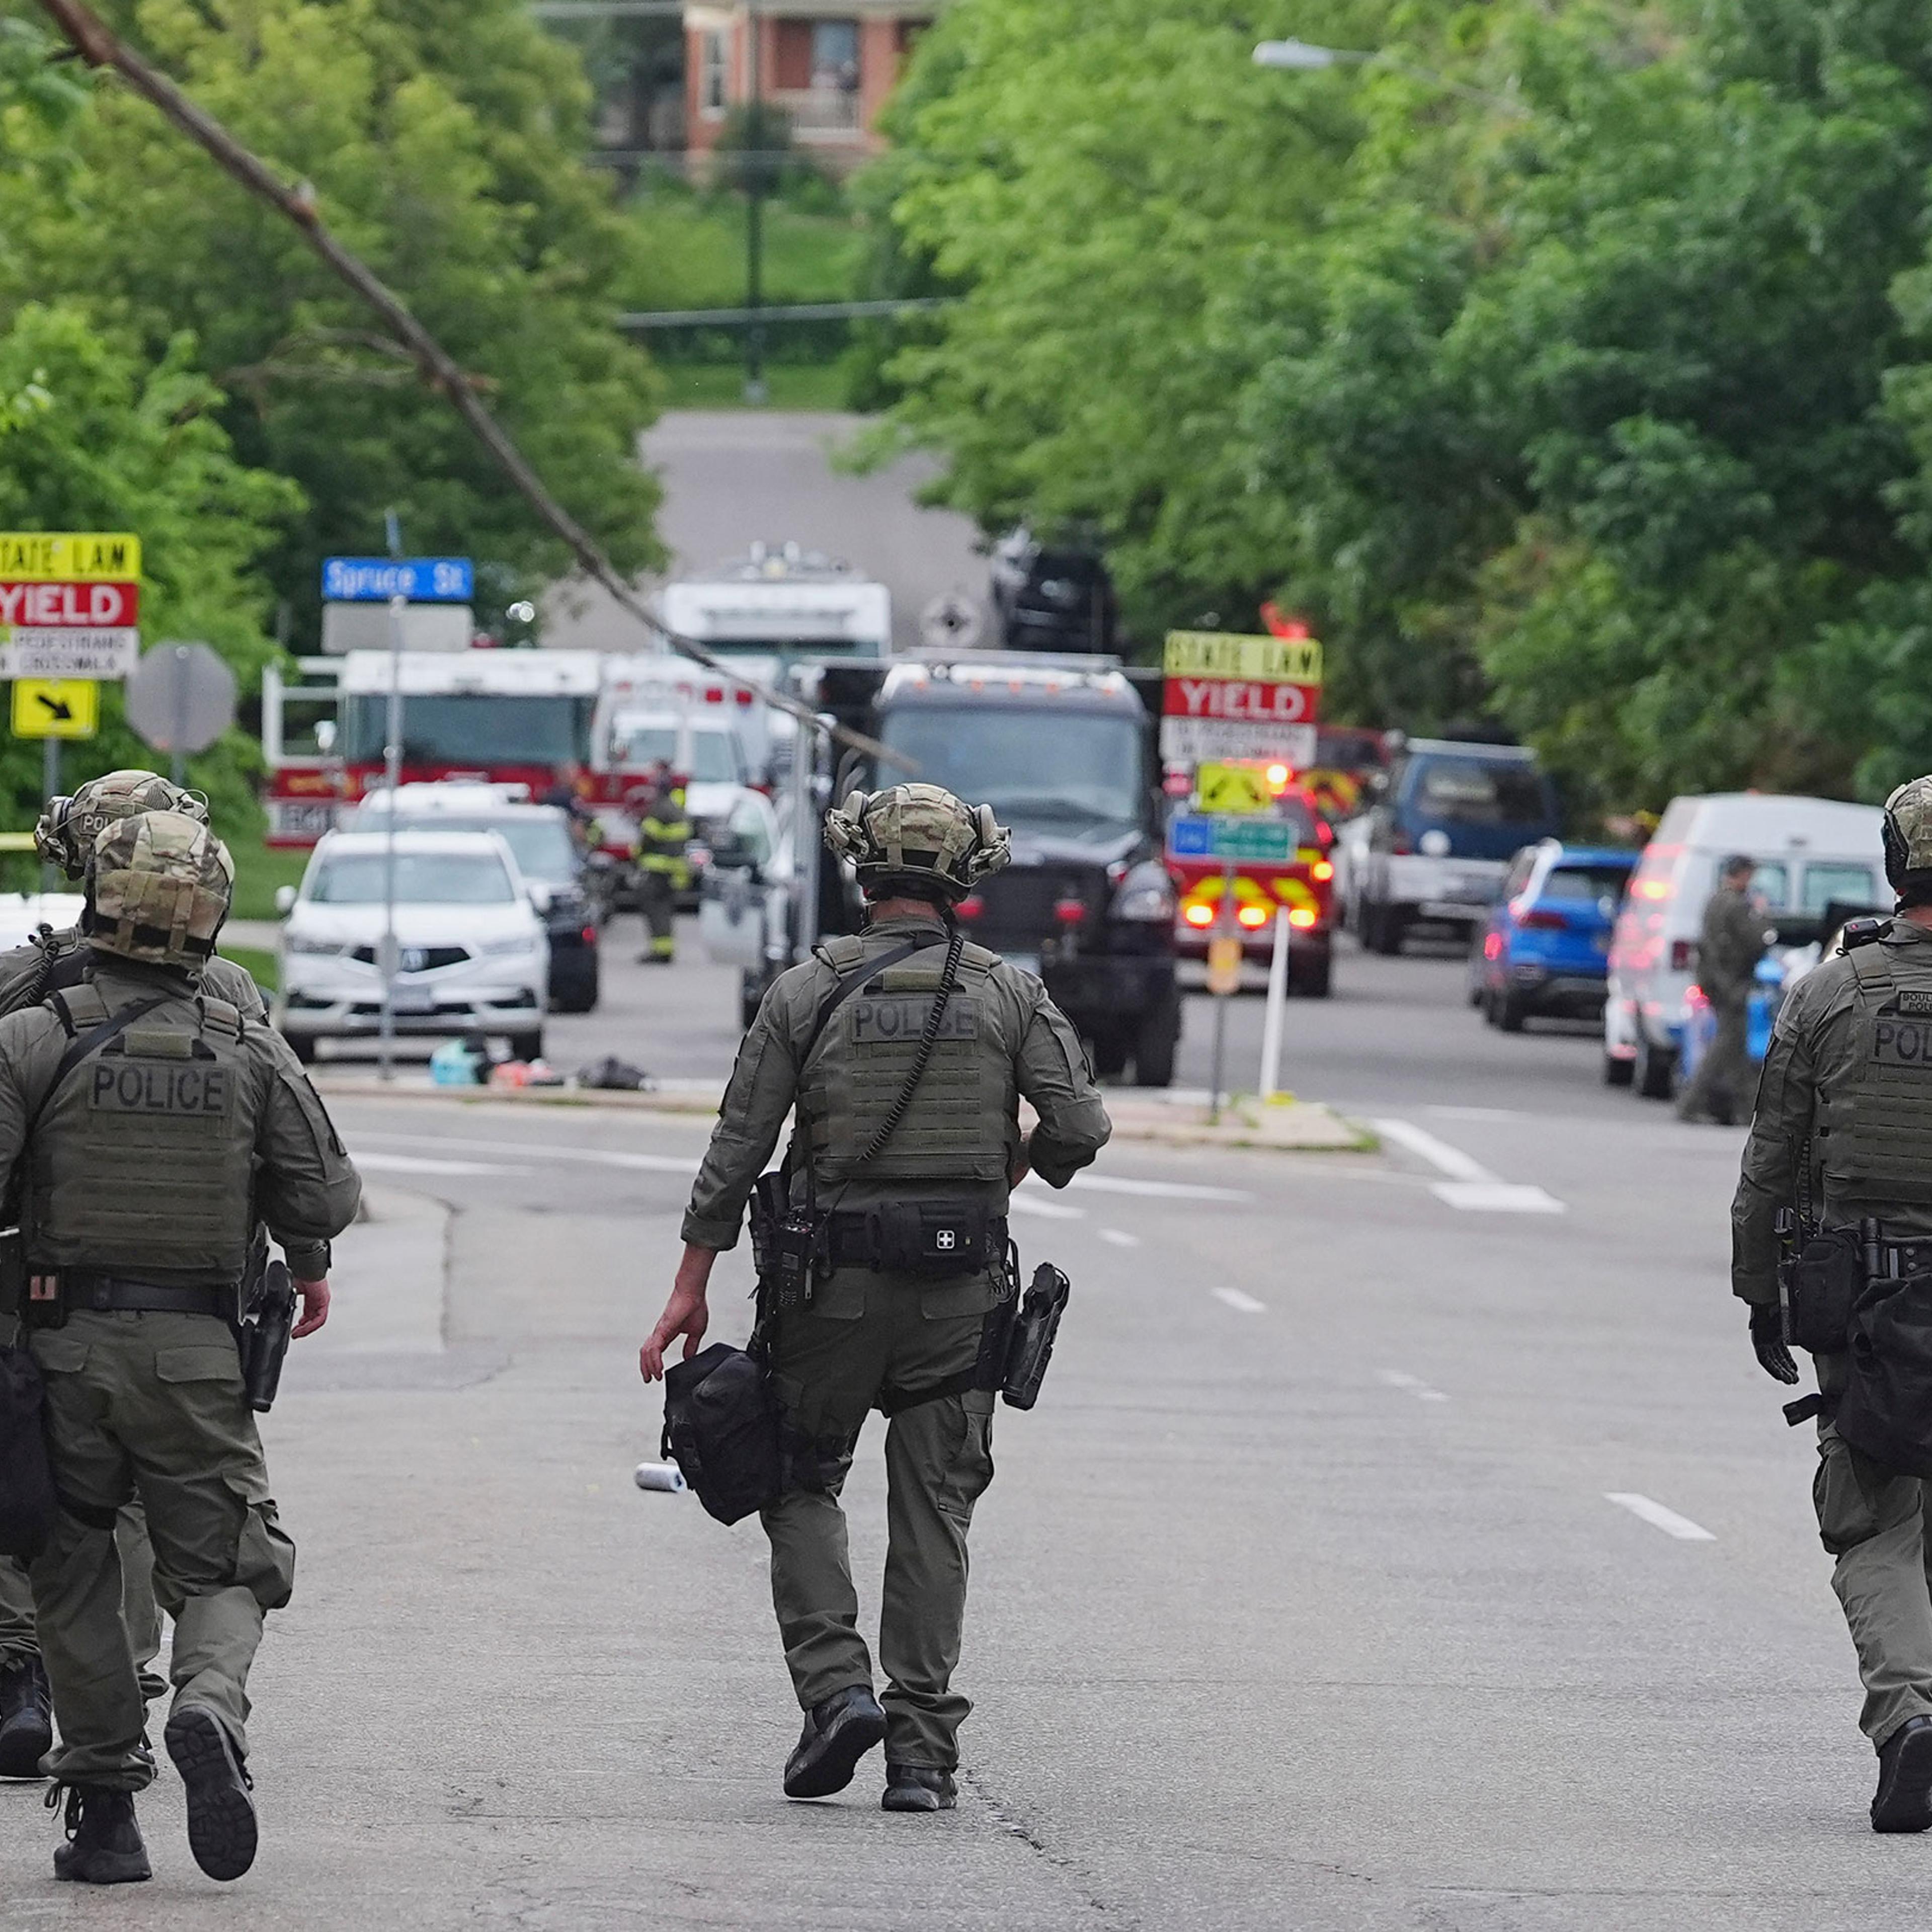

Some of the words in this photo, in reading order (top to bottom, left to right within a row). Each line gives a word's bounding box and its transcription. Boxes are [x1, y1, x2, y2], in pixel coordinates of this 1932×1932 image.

[0, 538, 54, 573] TATE
[73, 539, 128, 573] LAW
[326, 560, 417, 598] Spruce
[433, 561, 463, 595] St
[0, 584, 124, 624] YIELD
[1262, 641, 1319, 679] LAW
[1179, 679, 1305, 720] YIELD
[1903, 993, 1932, 1003] BOUL
[1909, 1002, 1932, 1011] POLI
[1875, 1022, 1932, 1061] POL
[94, 1065, 223, 1110] POLICE
